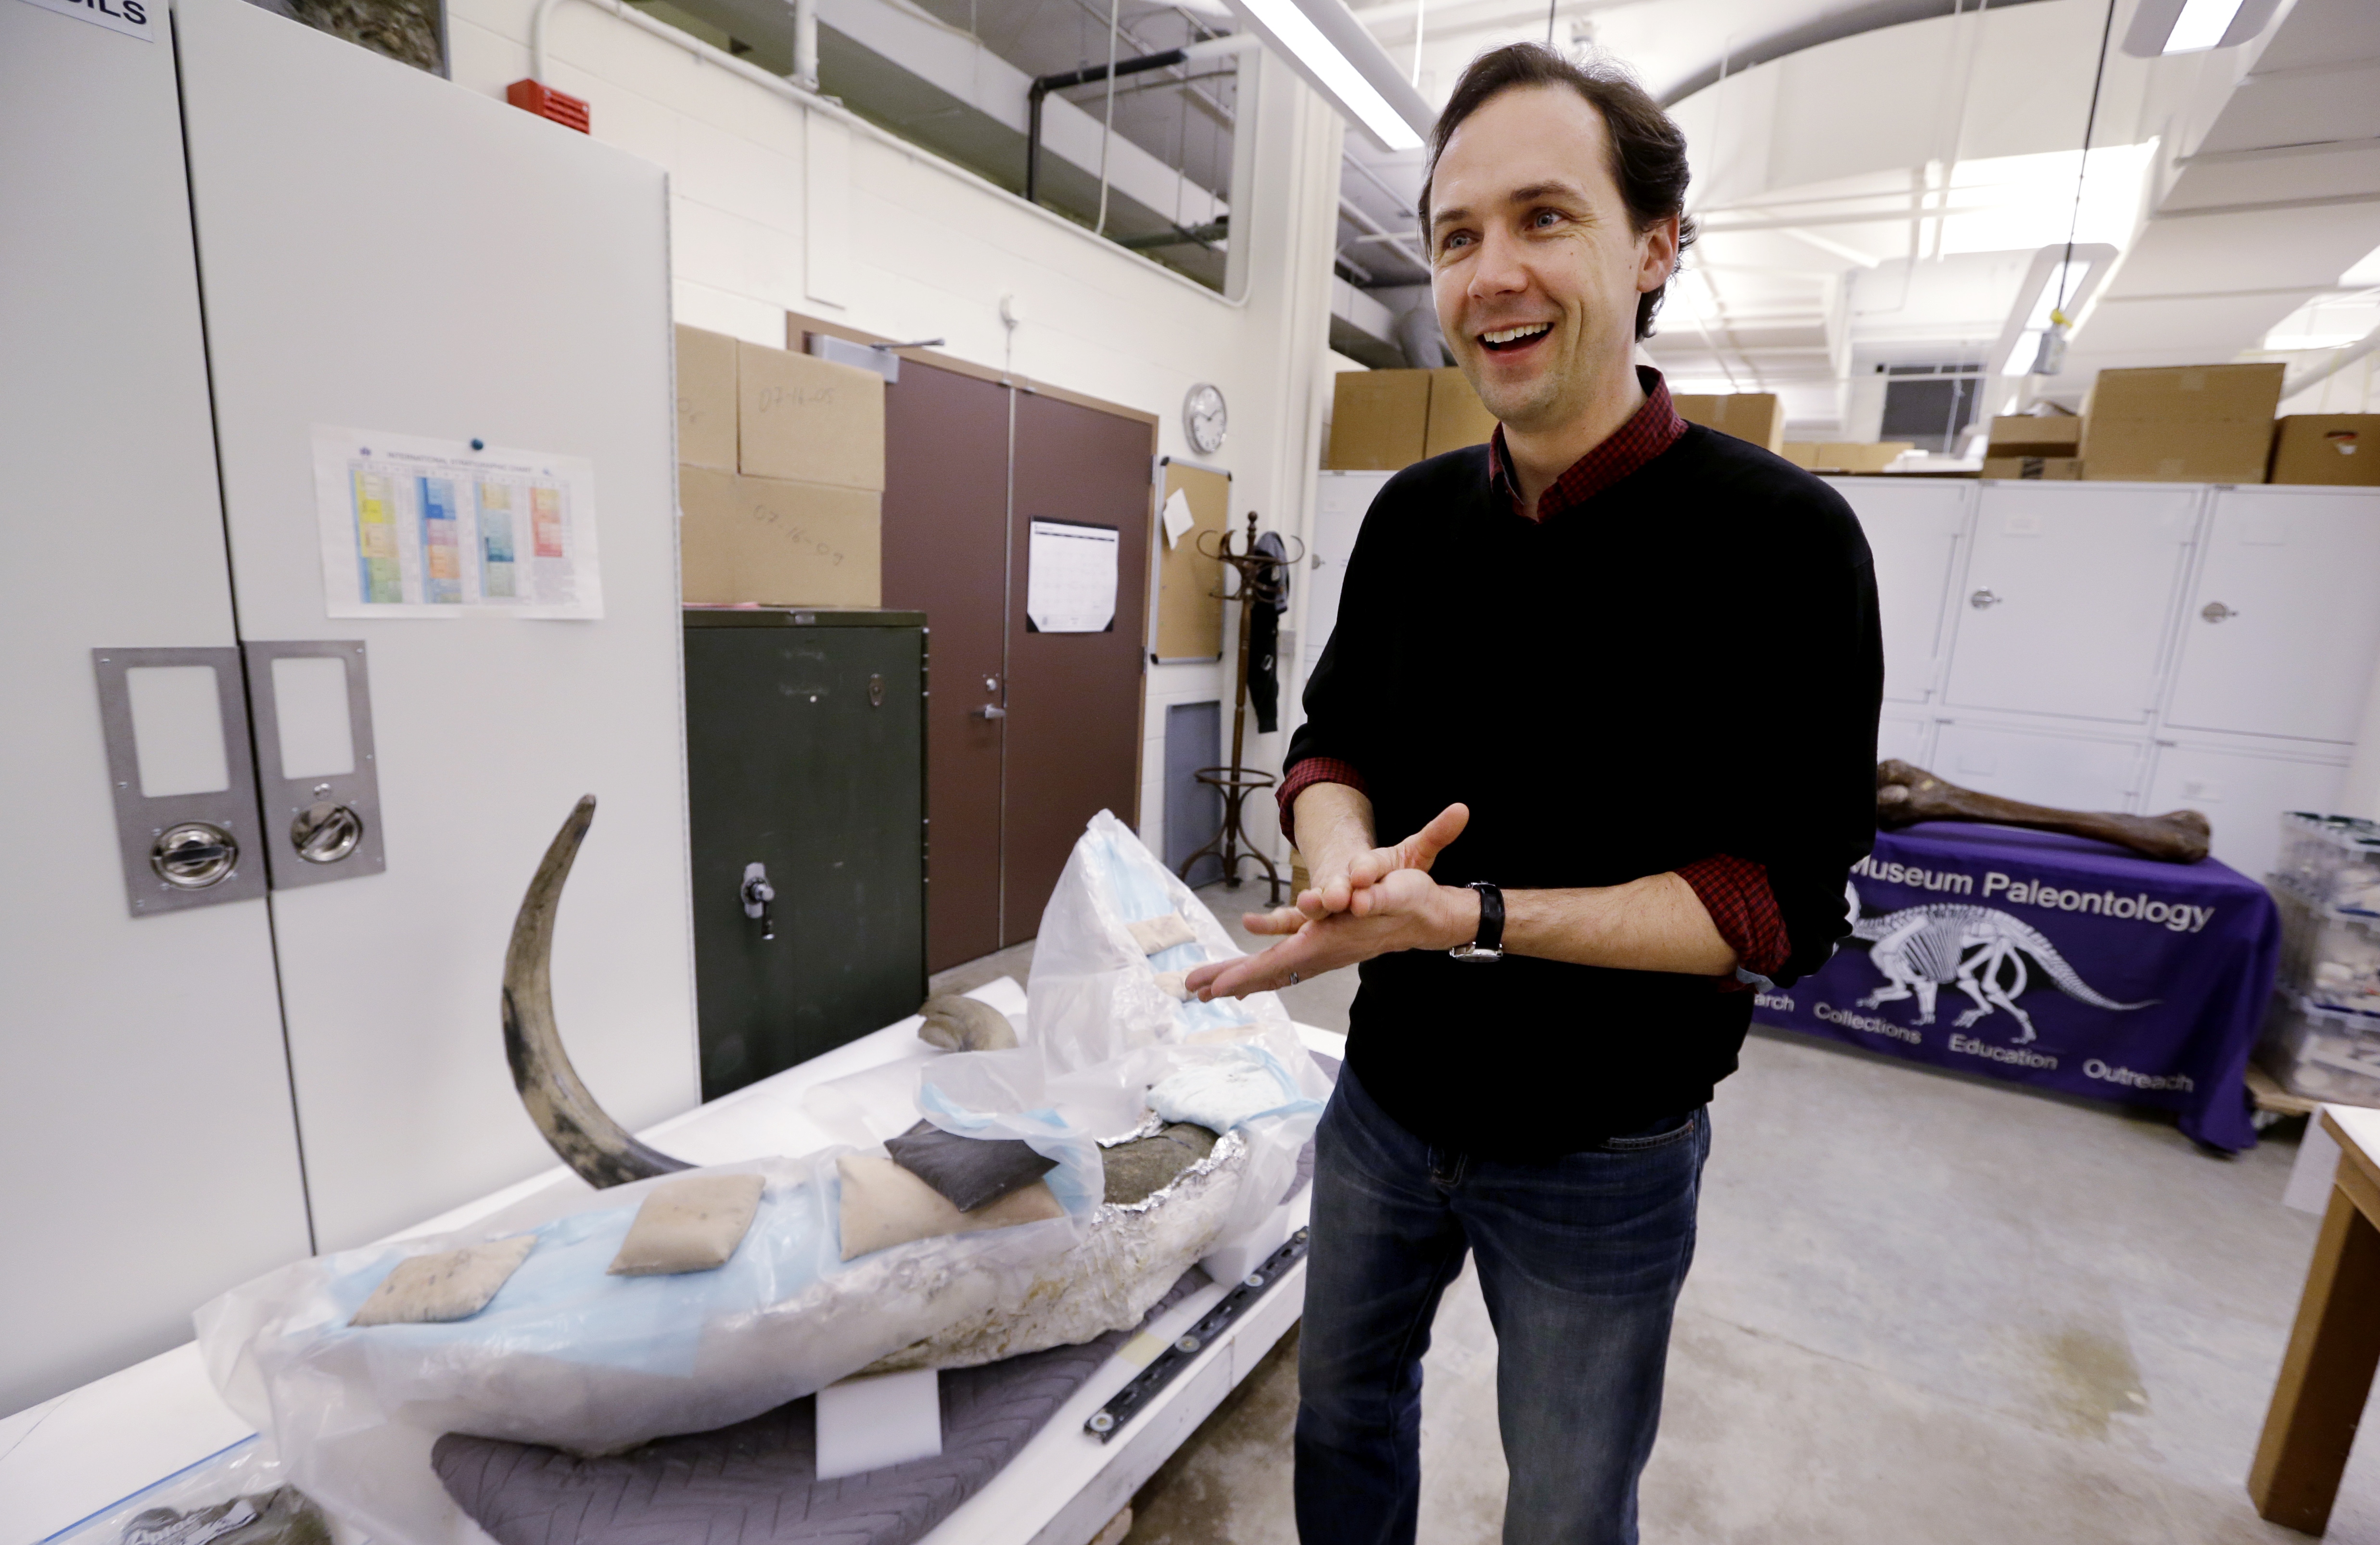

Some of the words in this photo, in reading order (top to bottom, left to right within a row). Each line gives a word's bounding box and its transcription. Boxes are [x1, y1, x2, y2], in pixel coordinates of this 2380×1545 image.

[1982, 872, 2215, 933] Paleontology
[1813, 1001, 1922, 1045] Collections
[1947, 1033, 2059, 1070] Education
[2082, 1058, 2194, 1093] Outreach
